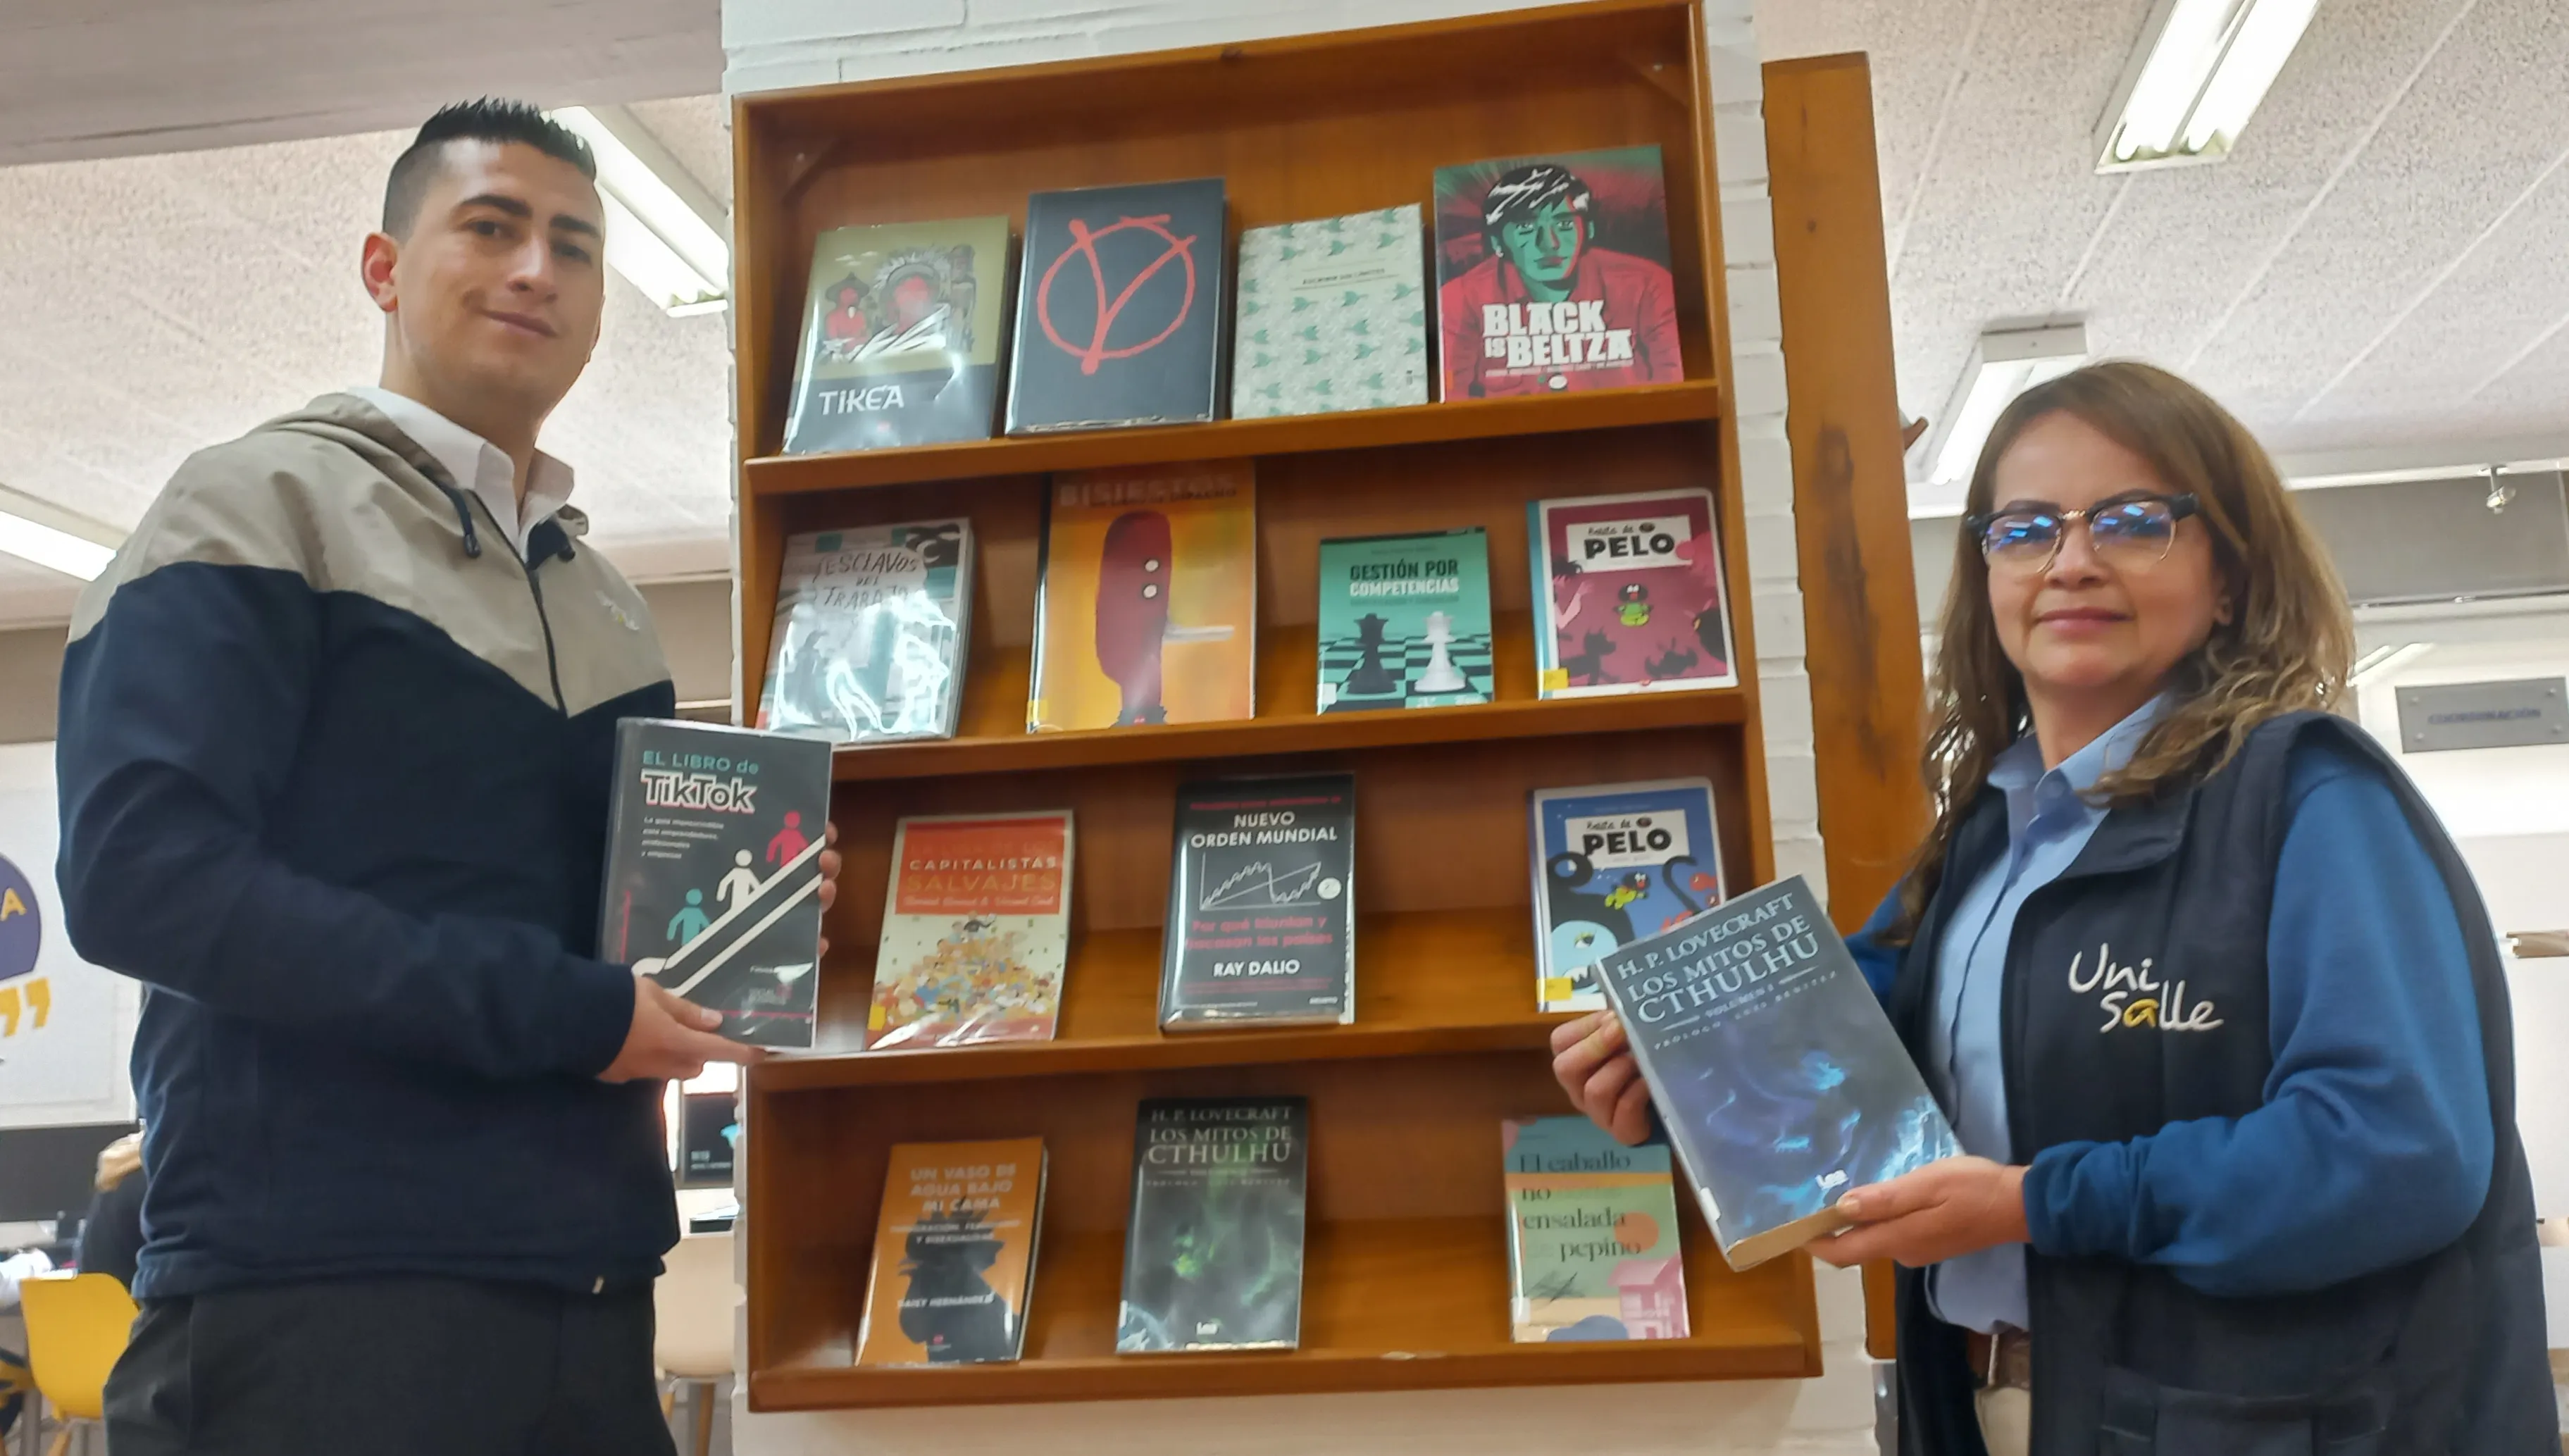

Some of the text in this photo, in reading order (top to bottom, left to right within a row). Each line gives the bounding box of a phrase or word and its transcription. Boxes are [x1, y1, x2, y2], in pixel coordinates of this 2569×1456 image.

[1482, 299, 1606, 337] BLACK
[1506, 328, 1634, 368] BELTZA
[819, 385, 904, 415] TIKEA
[1584, 533, 1675, 560] PELO
[1350, 558, 1458, 580] GESTIÓN POR
[1350, 577, 1460, 597] COMPETENCIAS
[642, 750, 759, 774] EL LIBRO de
[640, 768, 757, 814] TikTok
[1233, 811, 1295, 828] NUEVO
[1190, 826, 1338, 848] ORDEN MUNDIAL
[1583, 828, 1672, 856] PELO
[909, 856, 1057, 871] CAPITALISTAS
[906, 872, 1056, 892] SALVAJES
[1617, 892, 1793, 980] H. P. LOVECRAFT
[1213, 959, 1301, 977] RAY DALIO
[1626, 914, 1810, 1002] LOS MITOS DE
[2068, 942, 2160, 993] Uni
[1637, 931, 1820, 1023] CTHULHU
[1190, 1106, 1292, 1121] LOVECRAFT
[1150, 1126, 1292, 1143] LOS MITOS DE
[1147, 1142, 1291, 1164] CTHULHU
[1519, 1150, 1631, 1174] El caballo
[910, 1166, 938, 1181] UN
[944, 1165, 991, 1179] VASO
[910, 1179, 1013, 1197] AGUA BAJO
[1521, 1187, 1551, 1202] no
[922, 1197, 1000, 1212] MI CAMA
[1522, 1207, 1627, 1231] ensalada
[1560, 1238, 1641, 1262] pepino
